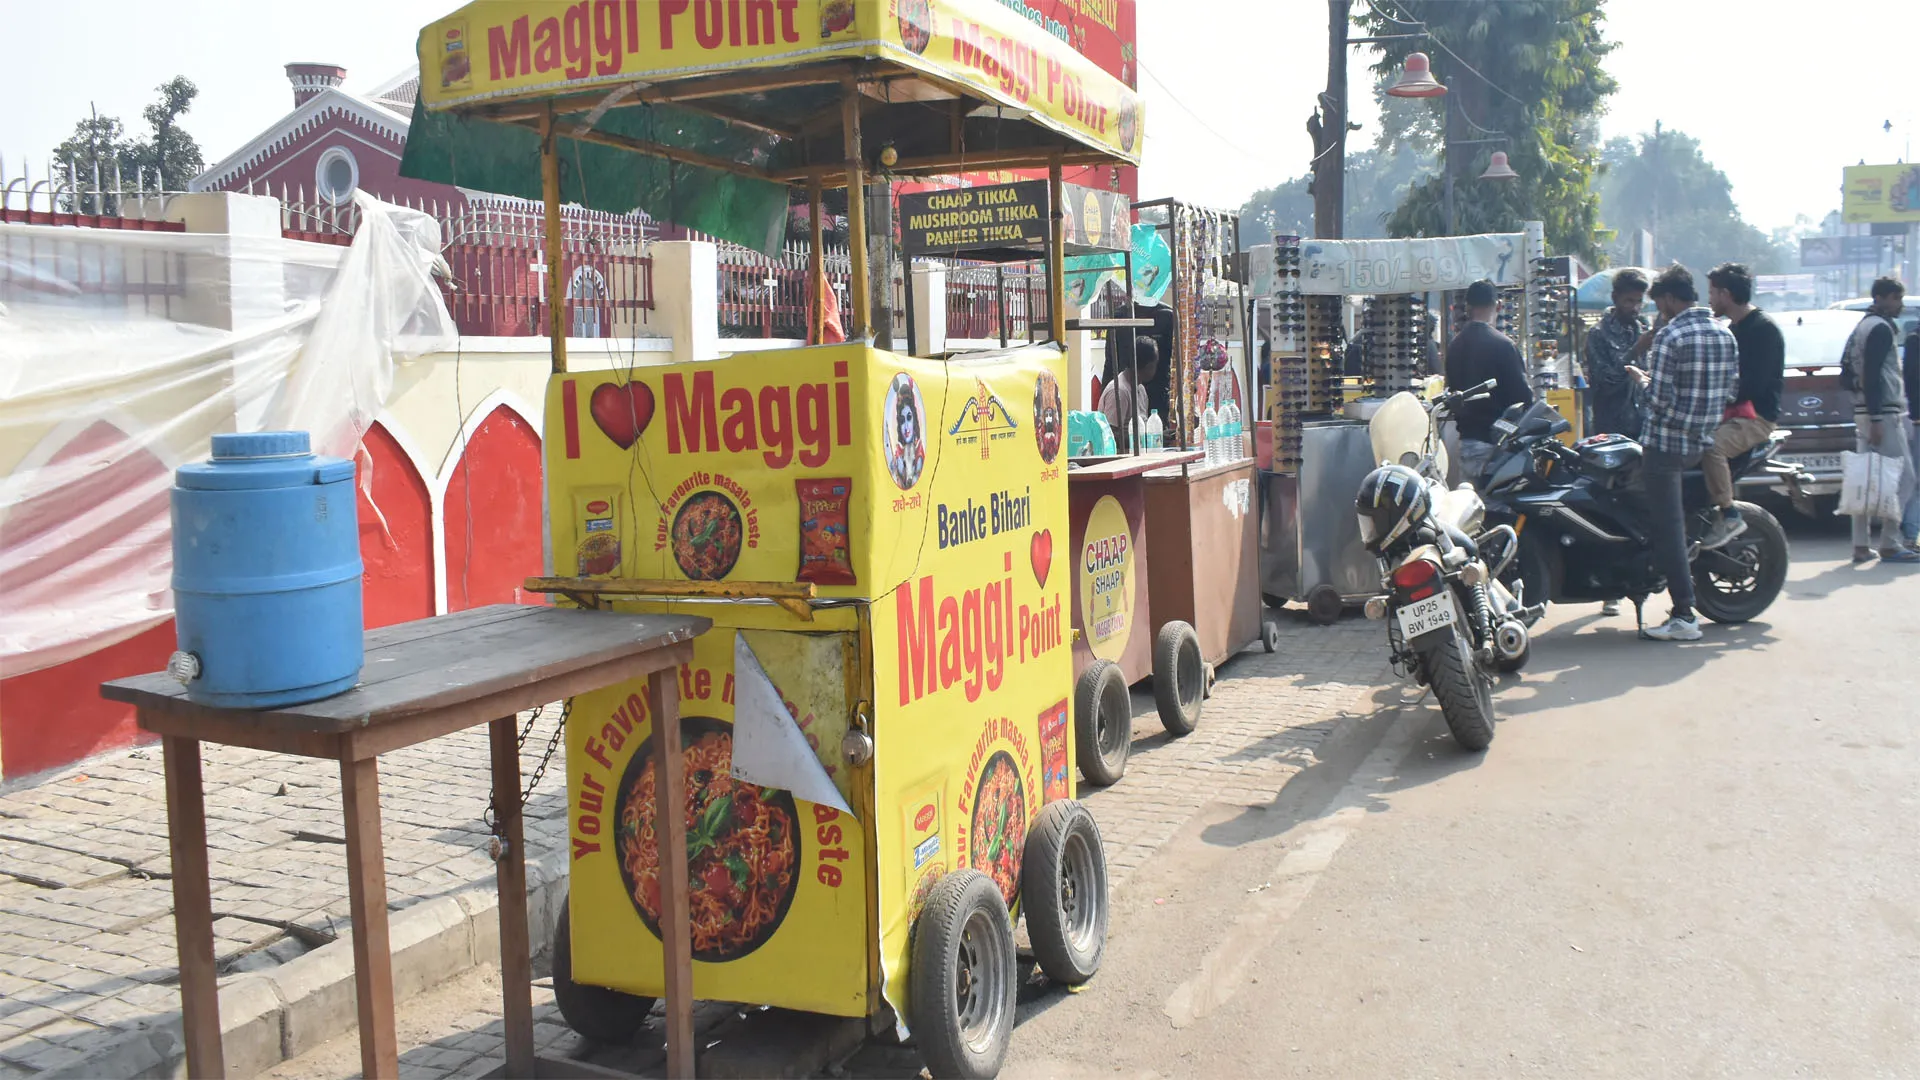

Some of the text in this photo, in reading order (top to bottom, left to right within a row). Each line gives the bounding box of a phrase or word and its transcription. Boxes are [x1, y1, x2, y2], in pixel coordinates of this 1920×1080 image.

[488, 0, 800, 80] Maggi Point
[952, 17, 1039, 104] Maggi
[1047, 53, 1108, 134] Point
[909, 204, 1038, 230] MUSHROOM TIKKA
[928, 188, 1018, 210] CHAAP TIKKA
[926, 224, 1022, 247] PANEER TIKKA
[562, 360, 851, 470] I Maggi
[655, 471, 760, 552] Your Favourite masala taste
[937, 485, 1031, 550] Banke Bihari
[1086, 534, 1127, 574] CHAAP
[1095, 570, 1120, 594] SHAAP
[895, 551, 1062, 707] Maggi Point
[1408, 610, 1450, 633] BW 1949
[1412, 600, 1438, 617] UP25
[572, 663, 711, 861] Your Favote
[957, 717, 1038, 870] our Favourite masala tast
[811, 803, 850, 888] aste
